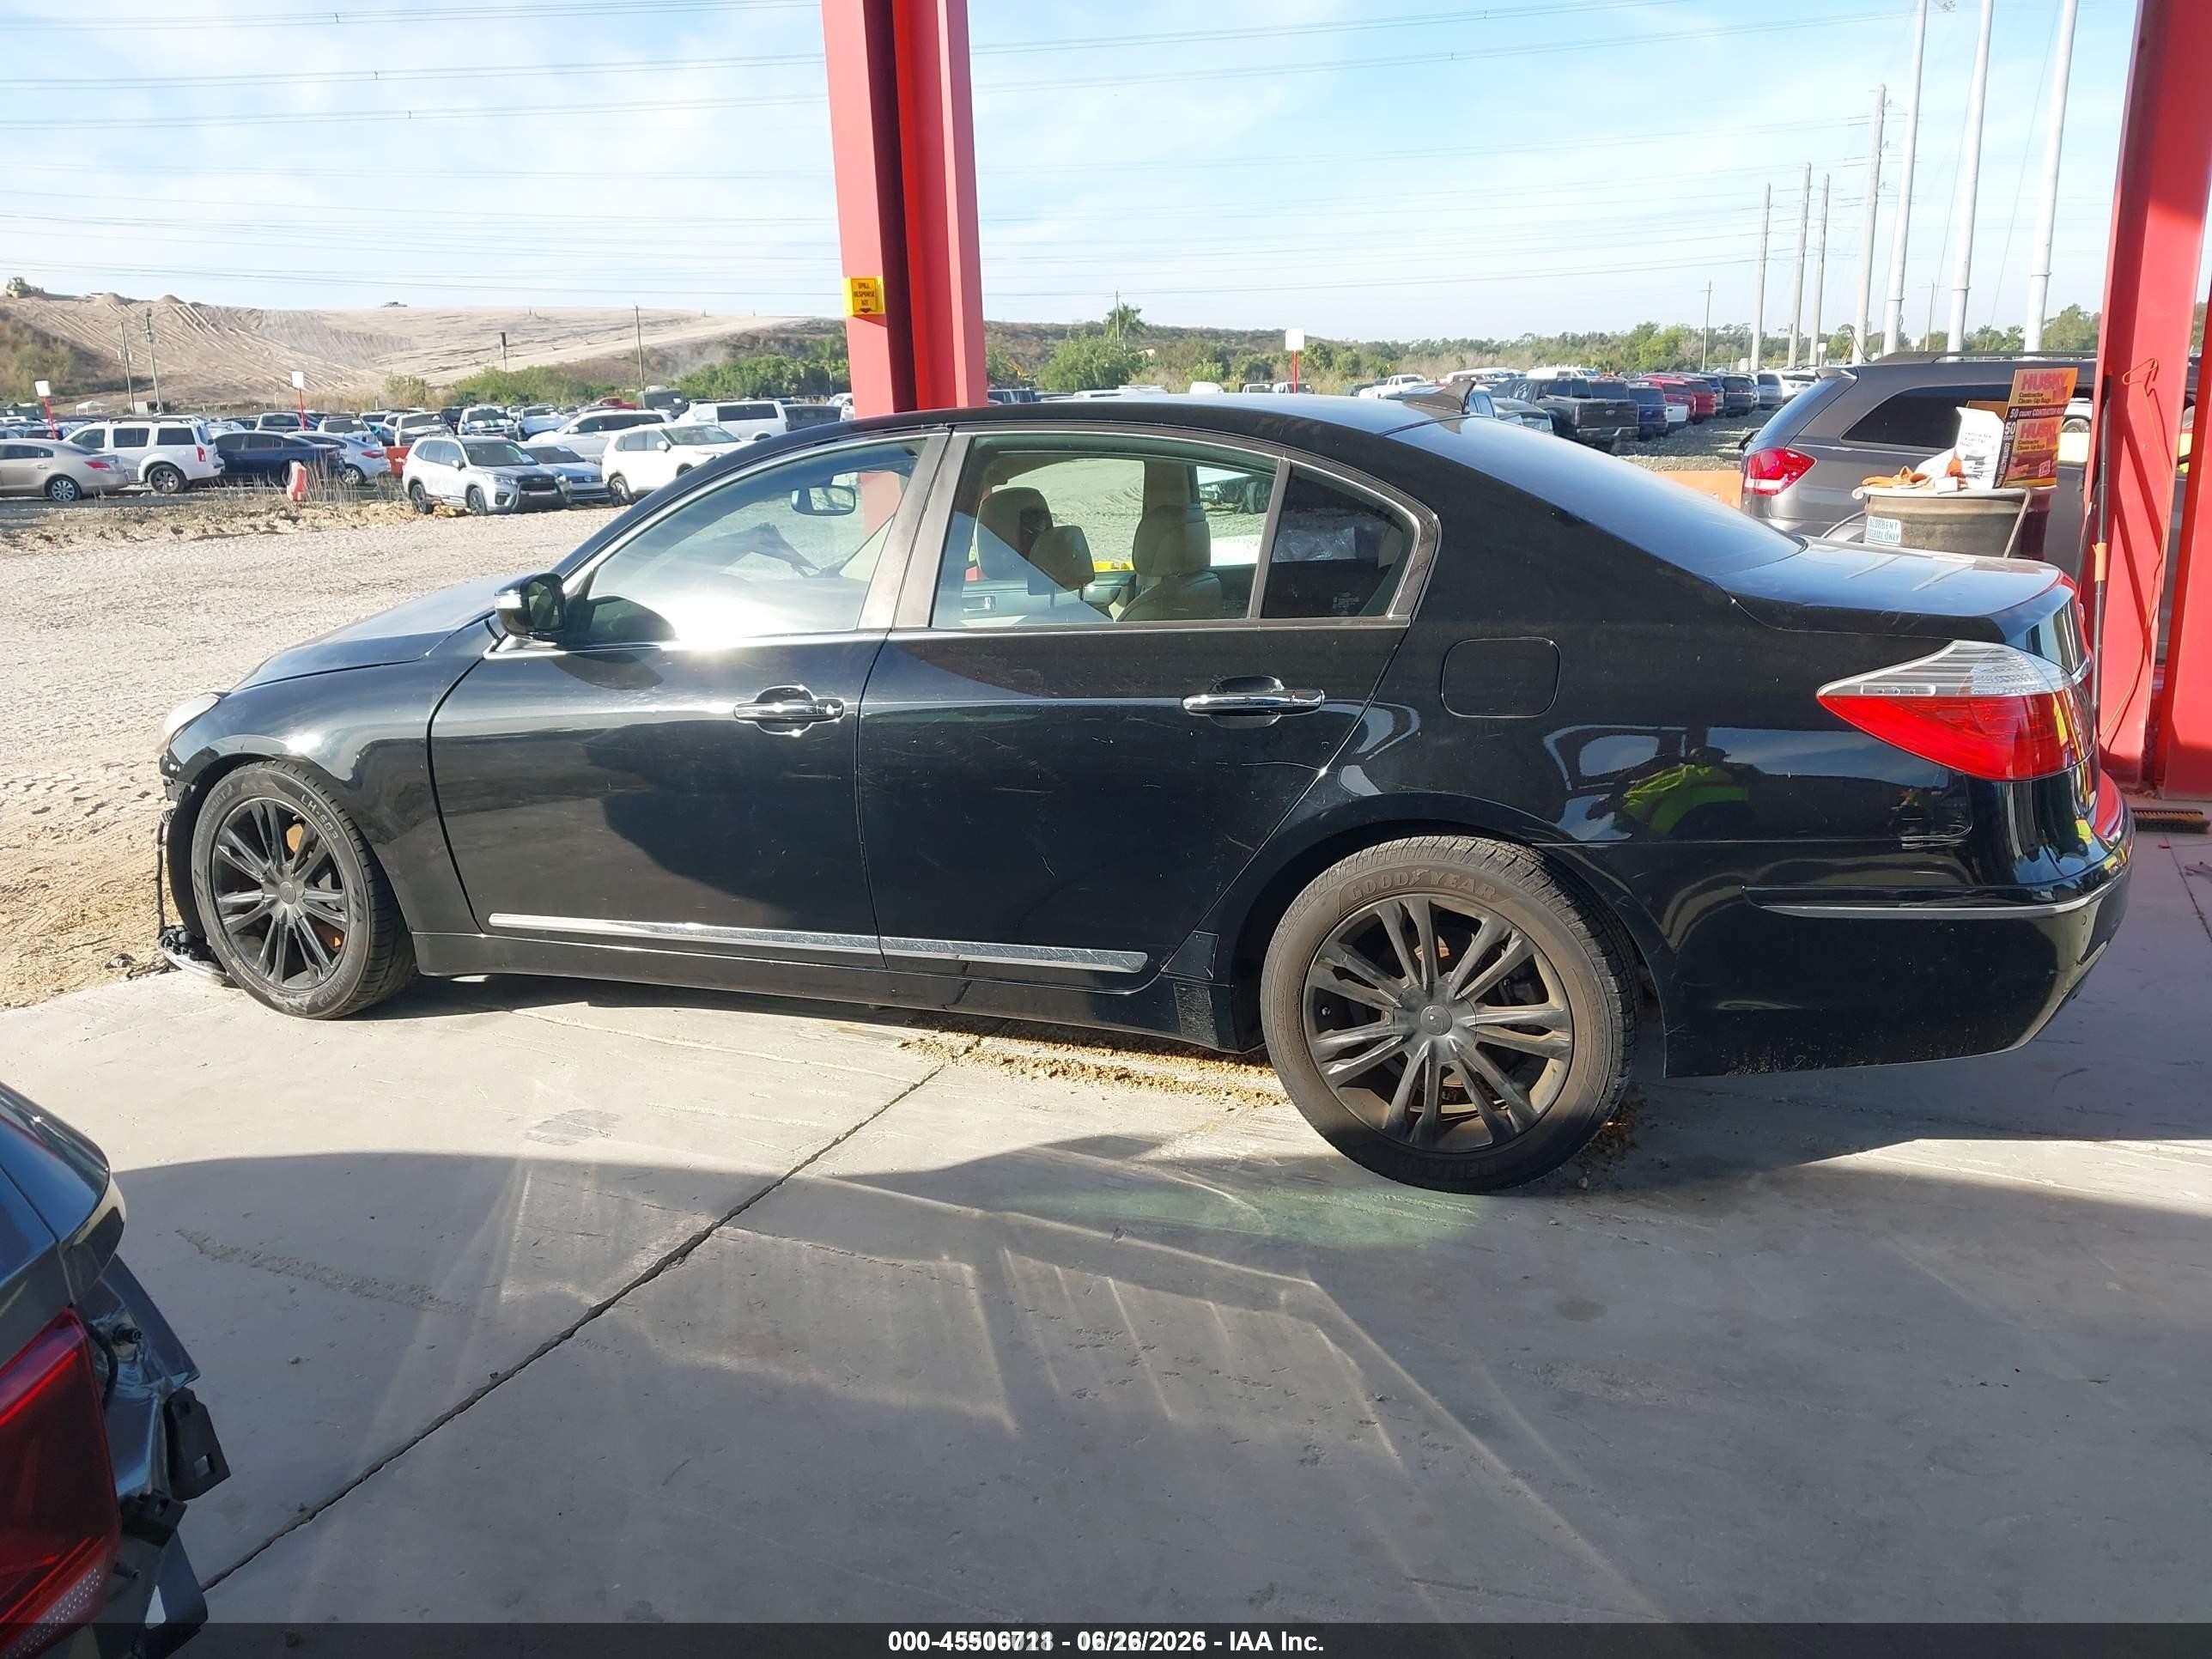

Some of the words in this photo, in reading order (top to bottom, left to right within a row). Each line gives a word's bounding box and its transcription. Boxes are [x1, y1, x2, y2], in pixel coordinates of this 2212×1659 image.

[2021, 372, 2069, 391] HUSKY
[2009, 408, 2020, 419] 50
[2004, 422, 2016, 435] 50
[2020, 421, 2058, 439] HUSKY
[1884, 529, 1900, 542] ONLY
[301, 793, 339, 840] LH-503
